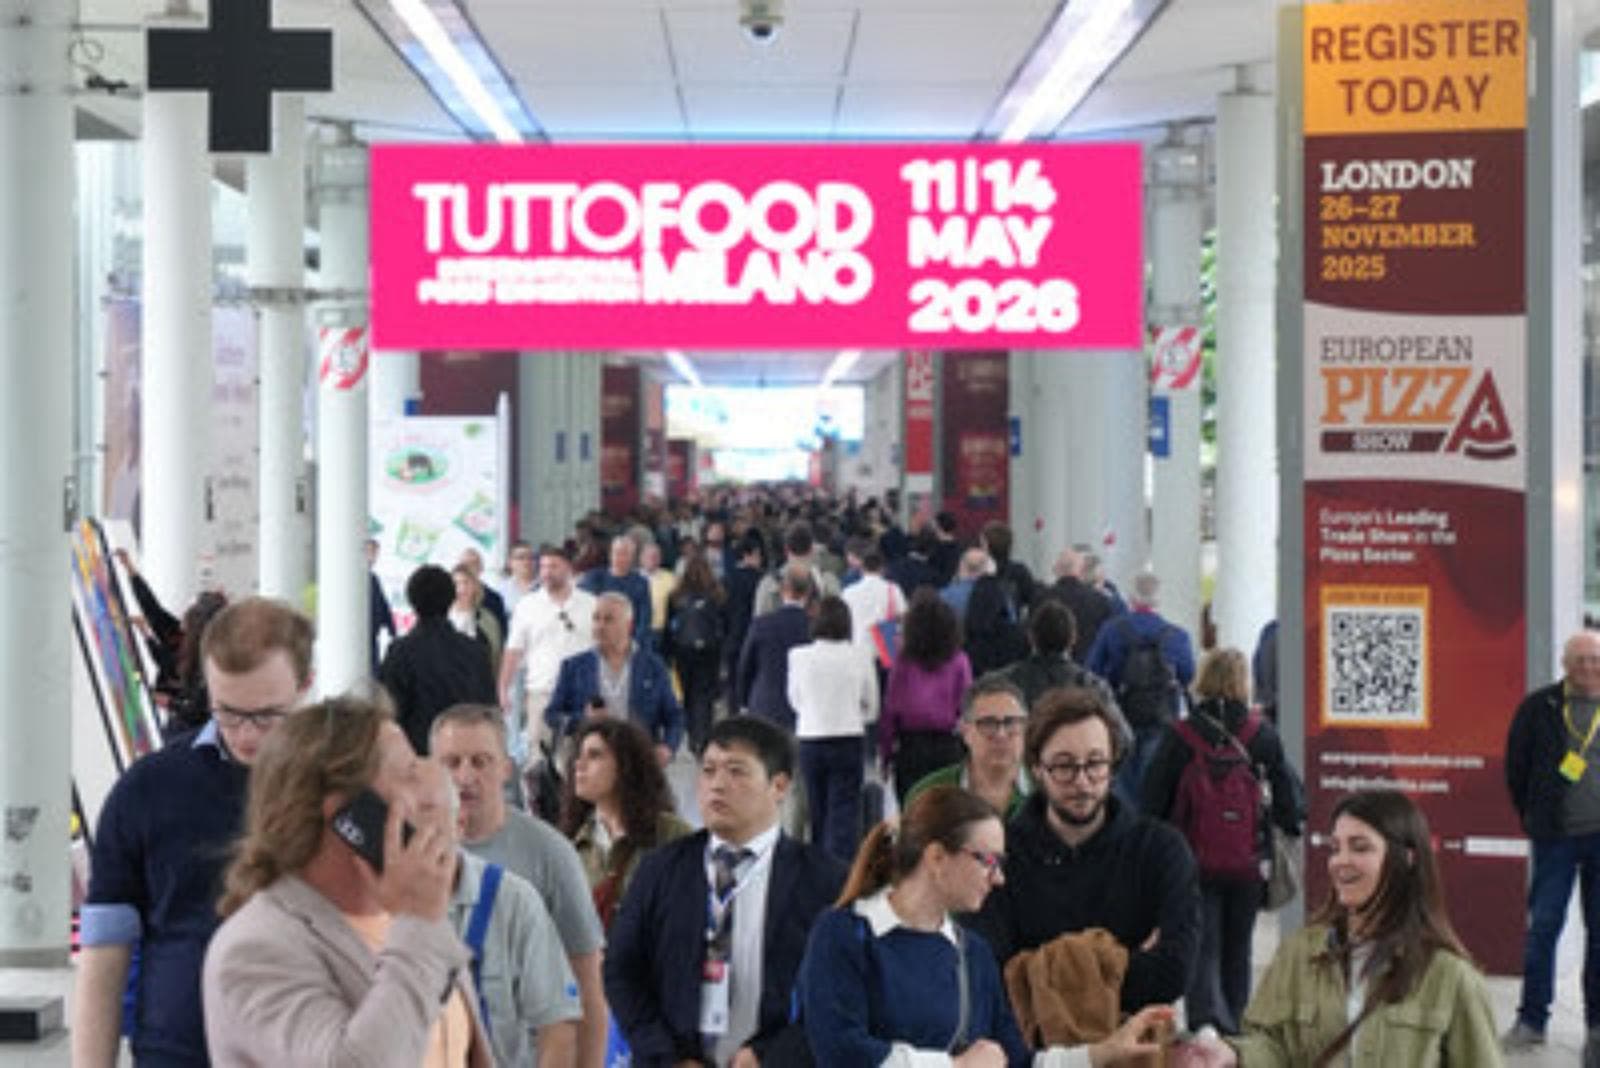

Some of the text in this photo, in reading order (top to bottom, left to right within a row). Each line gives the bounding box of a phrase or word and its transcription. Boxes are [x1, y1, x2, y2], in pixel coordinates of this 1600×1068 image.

[1310, 19, 1521, 63] REGISTER
[1337, 74, 1490, 116] TODAY
[1320, 158, 1475, 192] LONDON
[412, 180, 875, 254] TUTTOFOOD
[907, 215, 1053, 268] MAY
[1321, 222, 1476, 249] NOVEMBER
[641, 249, 874, 305] MILANO
[1321, 254, 1387, 281] 2025
[908, 278, 1080, 333] 2026
[1320, 335, 1473, 362] EUROPEAN
[1352, 430, 1412, 451] SHOW
[1320, 527, 1365, 544] Trade
[1368, 528, 1409, 544] Show
[1386, 508, 1449, 529] Leading
